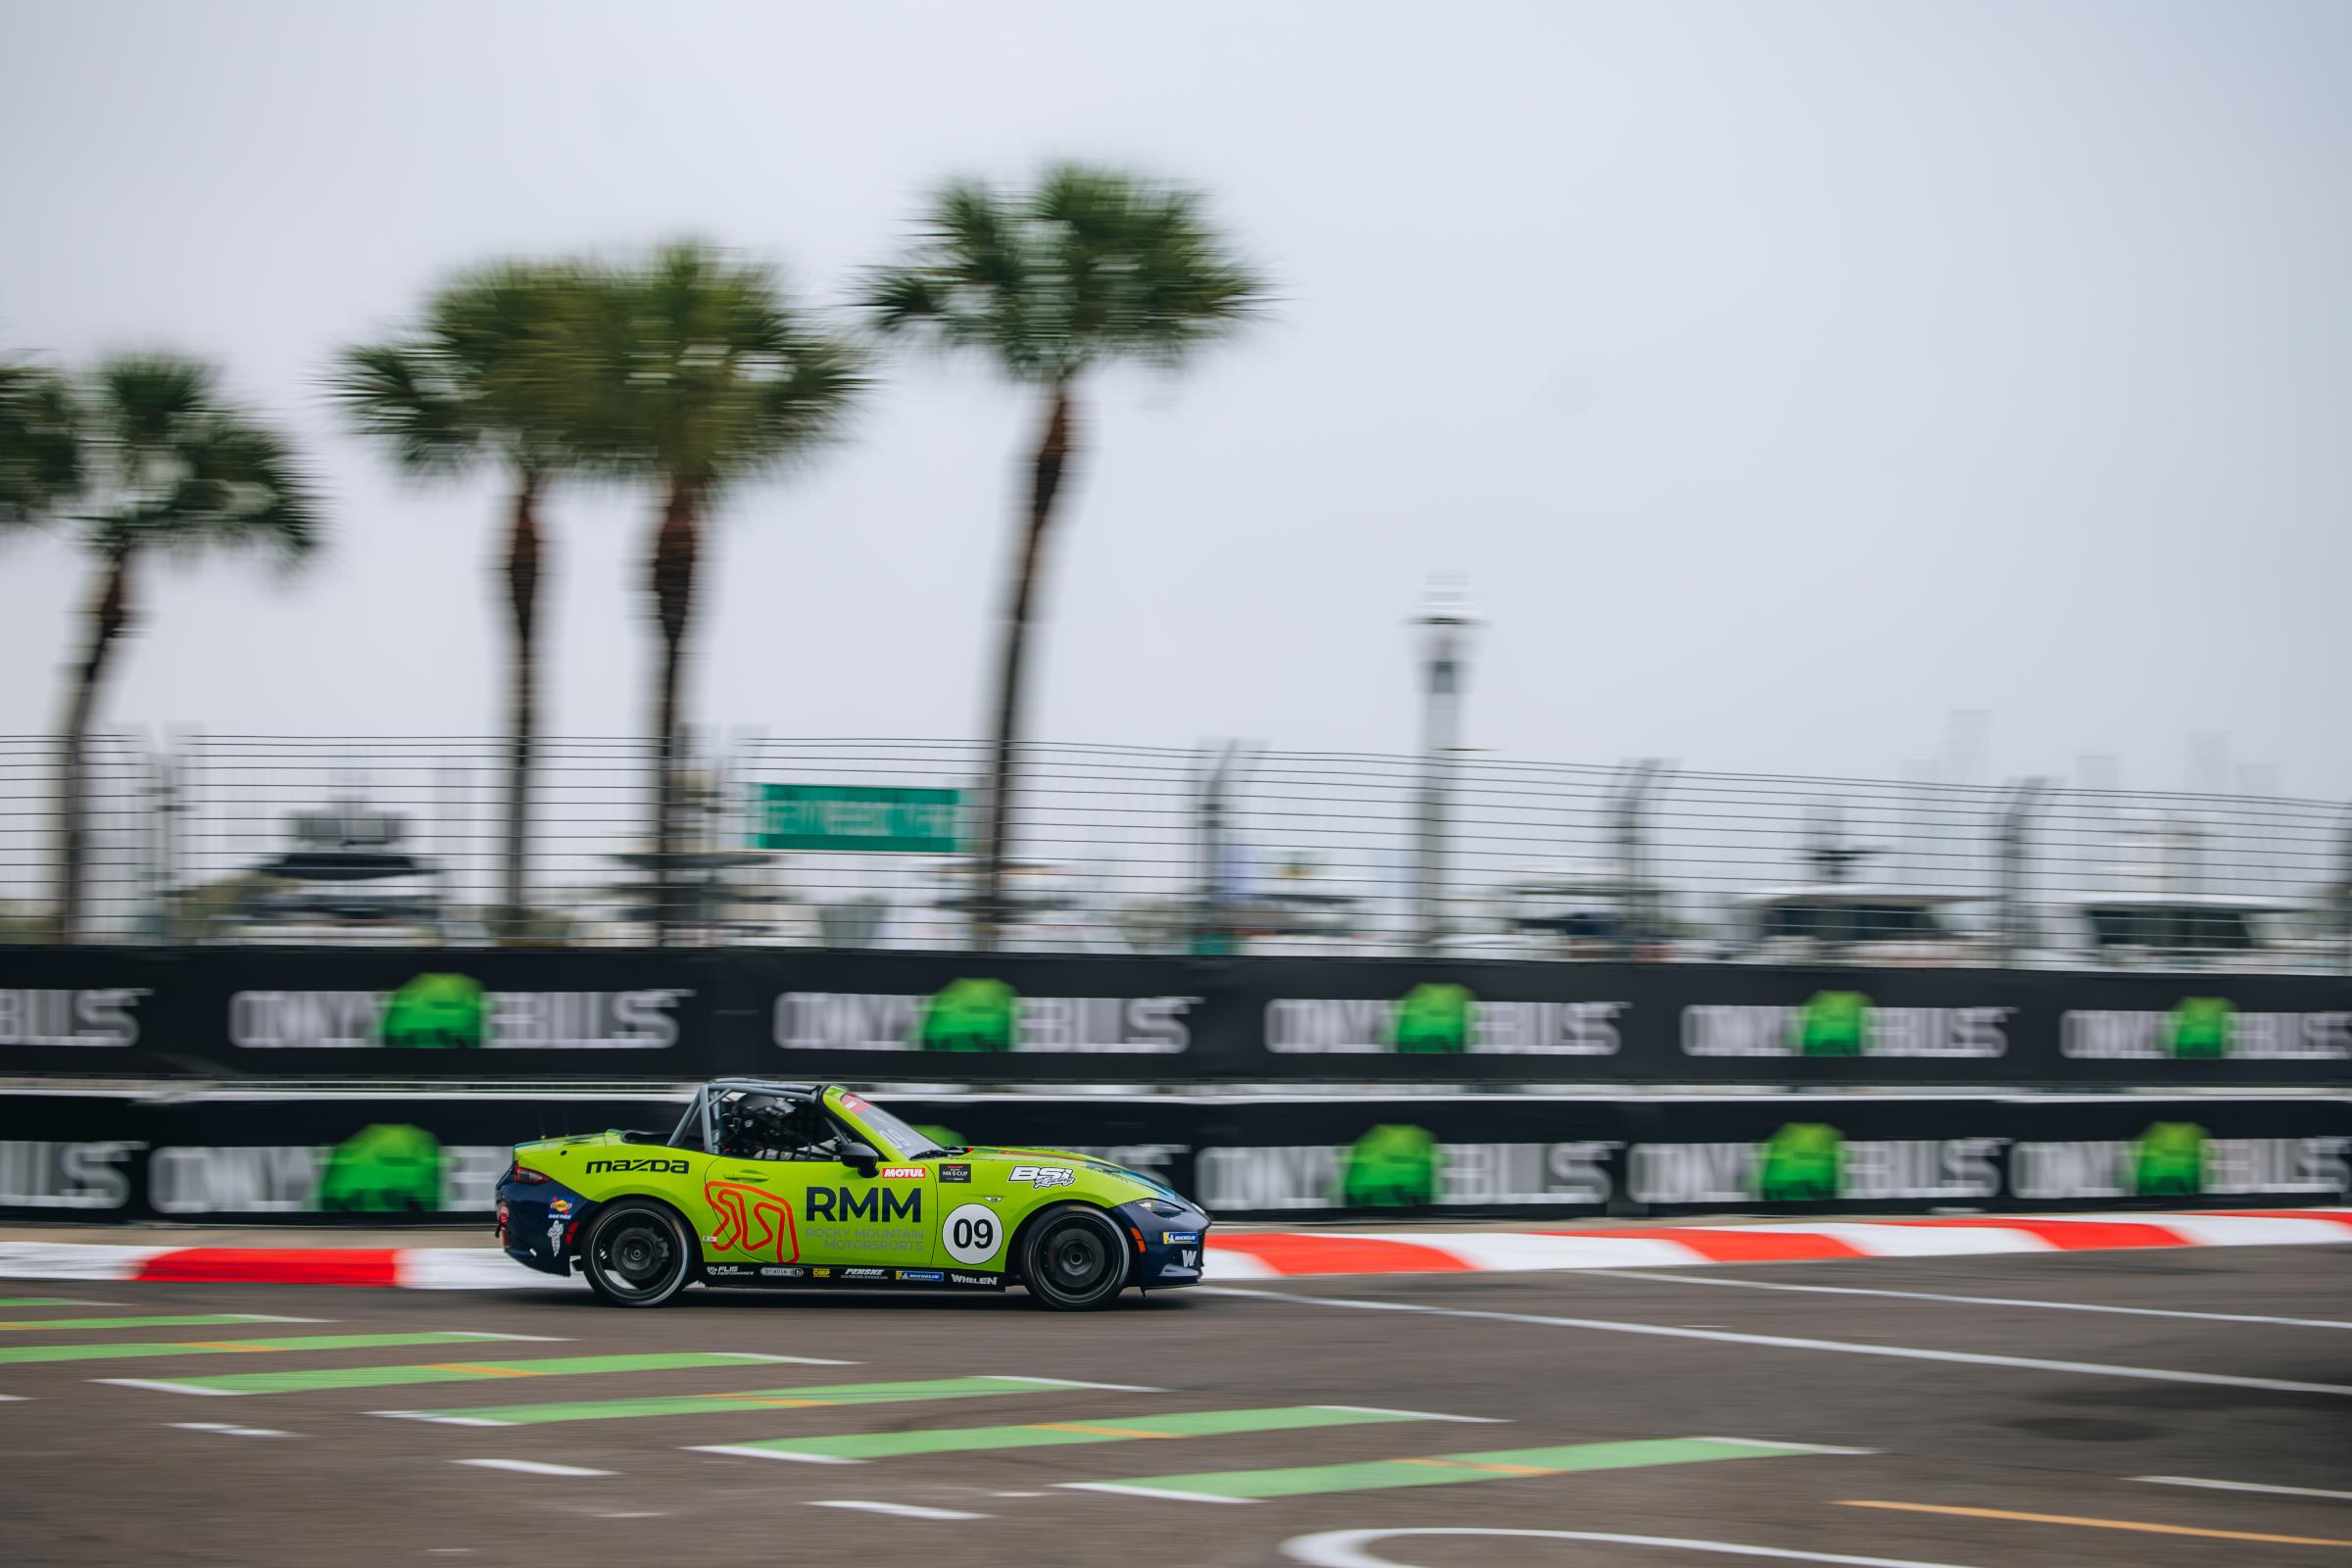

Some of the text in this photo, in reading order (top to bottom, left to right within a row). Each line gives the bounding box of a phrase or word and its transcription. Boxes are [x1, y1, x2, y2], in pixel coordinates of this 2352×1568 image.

[884, 1168, 924, 1178] MOTUL
[806, 1186, 922, 1223] RMM
[806, 1227, 924, 1240] ROCKY MOUNTAIN
[953, 1218, 994, 1250] 09
[823, 1240, 924, 1251] MOTORSPORTS
[1182, 1250, 1198, 1268] W
